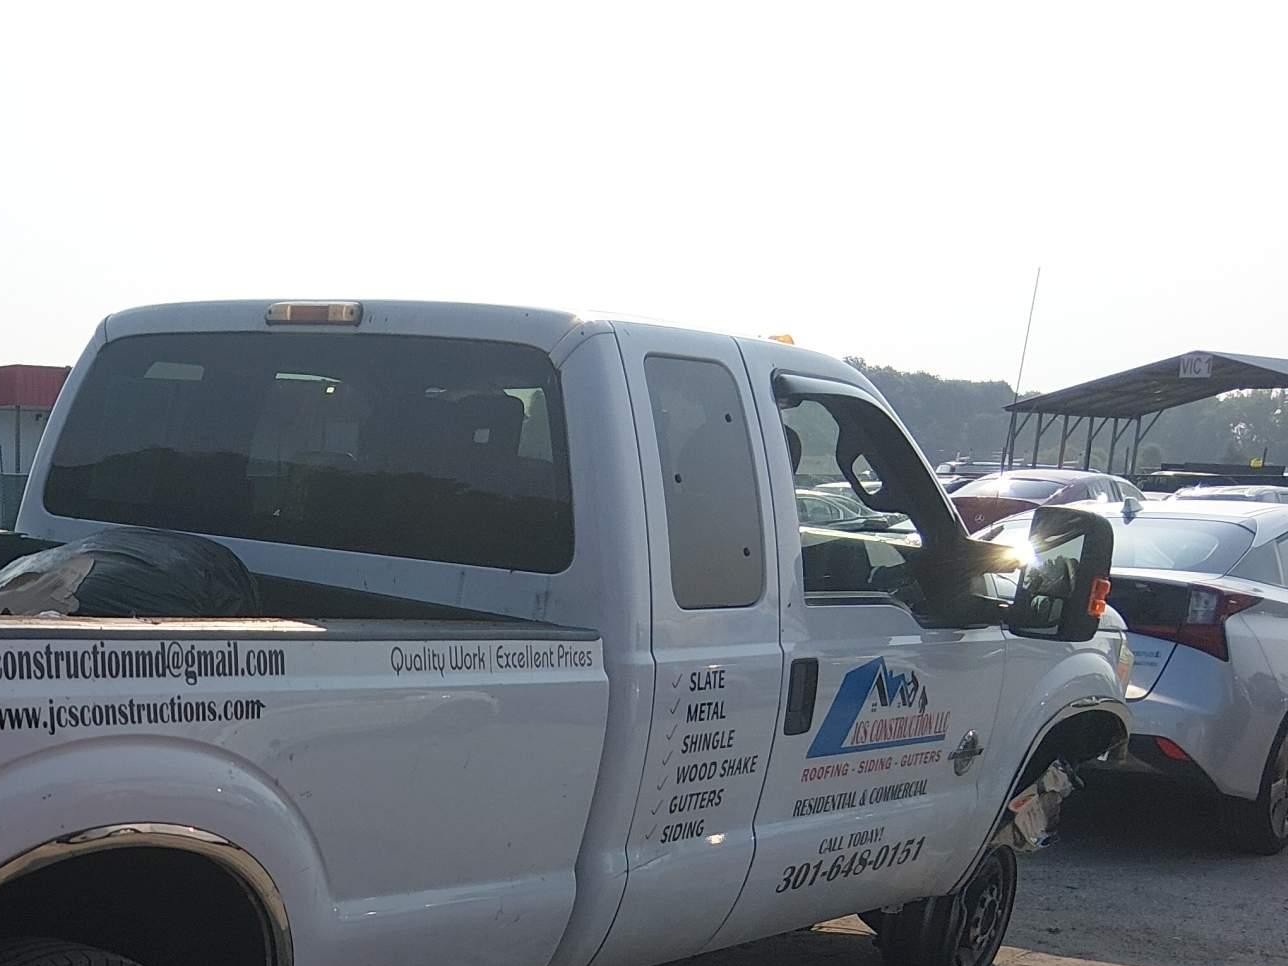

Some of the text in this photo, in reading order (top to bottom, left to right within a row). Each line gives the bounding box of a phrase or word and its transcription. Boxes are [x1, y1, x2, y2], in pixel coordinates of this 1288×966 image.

[1181, 358, 1201, 375] VIC
[391, 646, 445, 678] Quality
[449, 645, 486, 671] Work
[496, 645, 554, 669] Excellent
[557, 644, 593, 667] Prices
[689, 670, 725, 692] SLATE
[686, 702, 726, 723] METAL
[870, 714, 933, 742] CONSTRUCTION
[934, 712, 951, 734] LLC
[681, 729, 735, 754] SHINGLE
[676, 755, 759, 784] WOOD SHAKE
[801, 762, 849, 782] ROOFING
[857, 756, 892, 775] SIDING
[900, 750, 942, 767] GUTTERS
[669, 789, 725, 814] GUTTERS
[792, 779, 928, 817] RESIDENTIAL & COMMERCIAL
[660, 819, 705, 844] SIDING
[818, 827, 885, 854] CALL TODAY!
[775, 836, 927, 893] 301-648-0151
